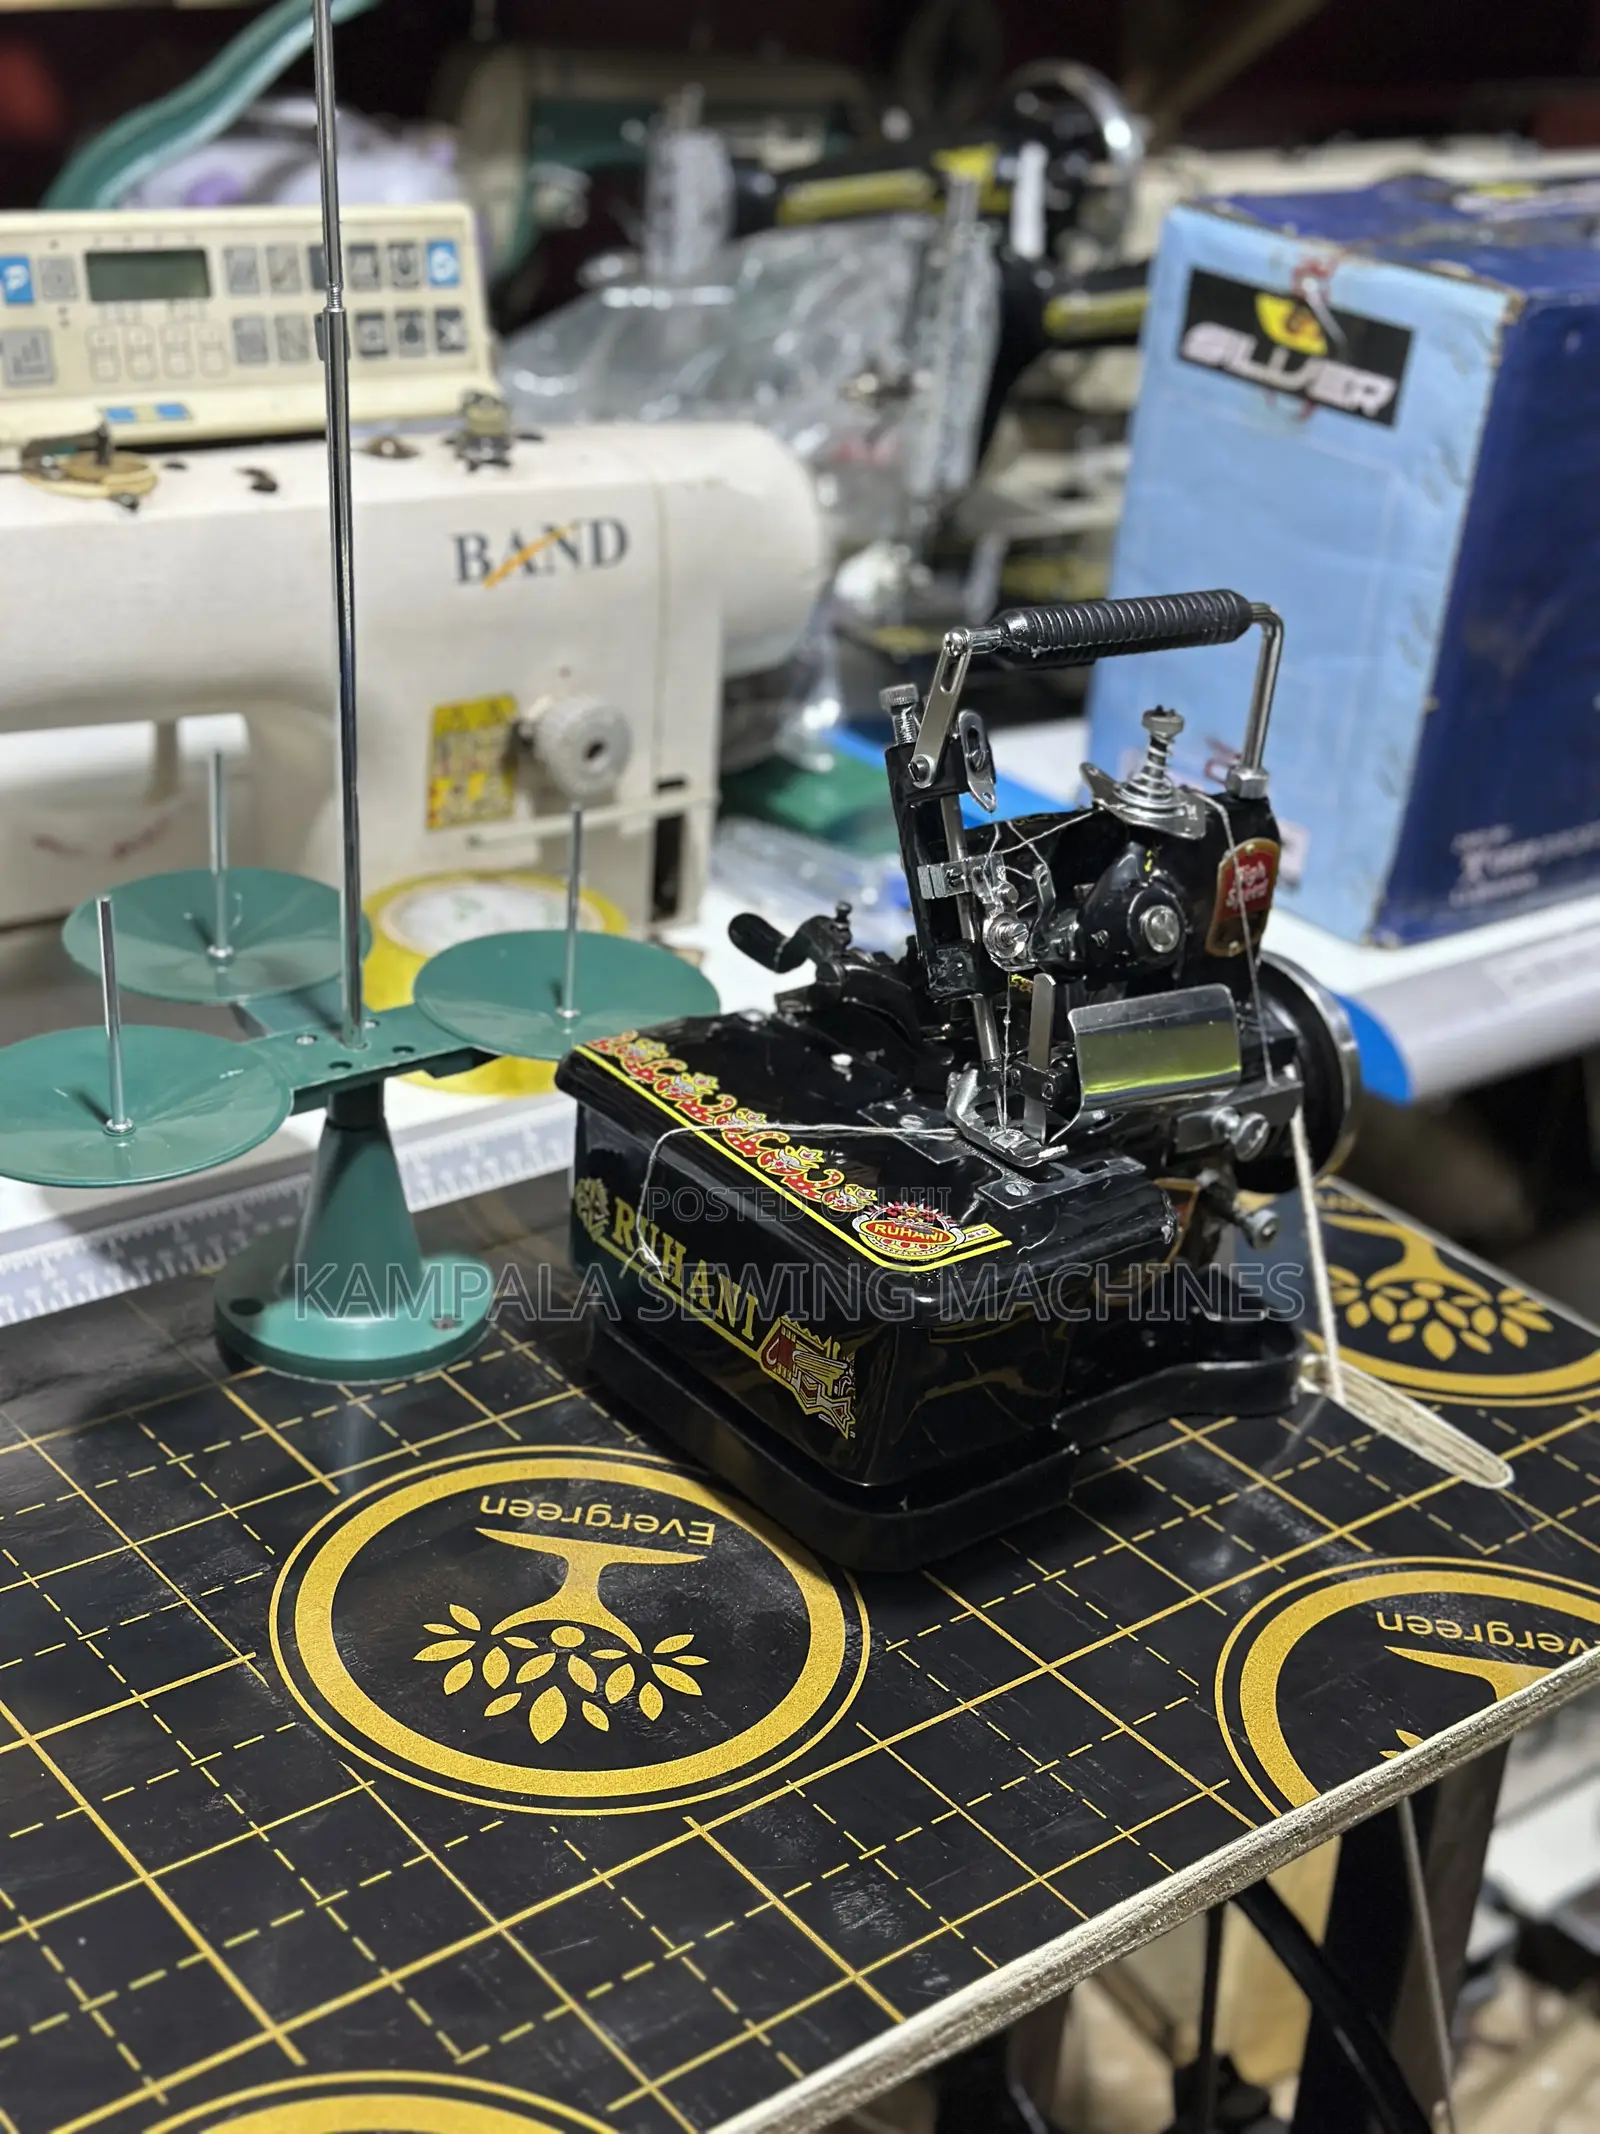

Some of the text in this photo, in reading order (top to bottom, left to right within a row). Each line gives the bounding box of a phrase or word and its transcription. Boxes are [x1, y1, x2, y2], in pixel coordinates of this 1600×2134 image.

[452, 517, 629, 585] BAND
[873, 1223, 944, 1242] RUHANI
[611, 1196, 758, 1341] RUHANI
[479, 1494, 716, 1546] Evergreen
[1376, 1610, 1600, 1656] vergreen
